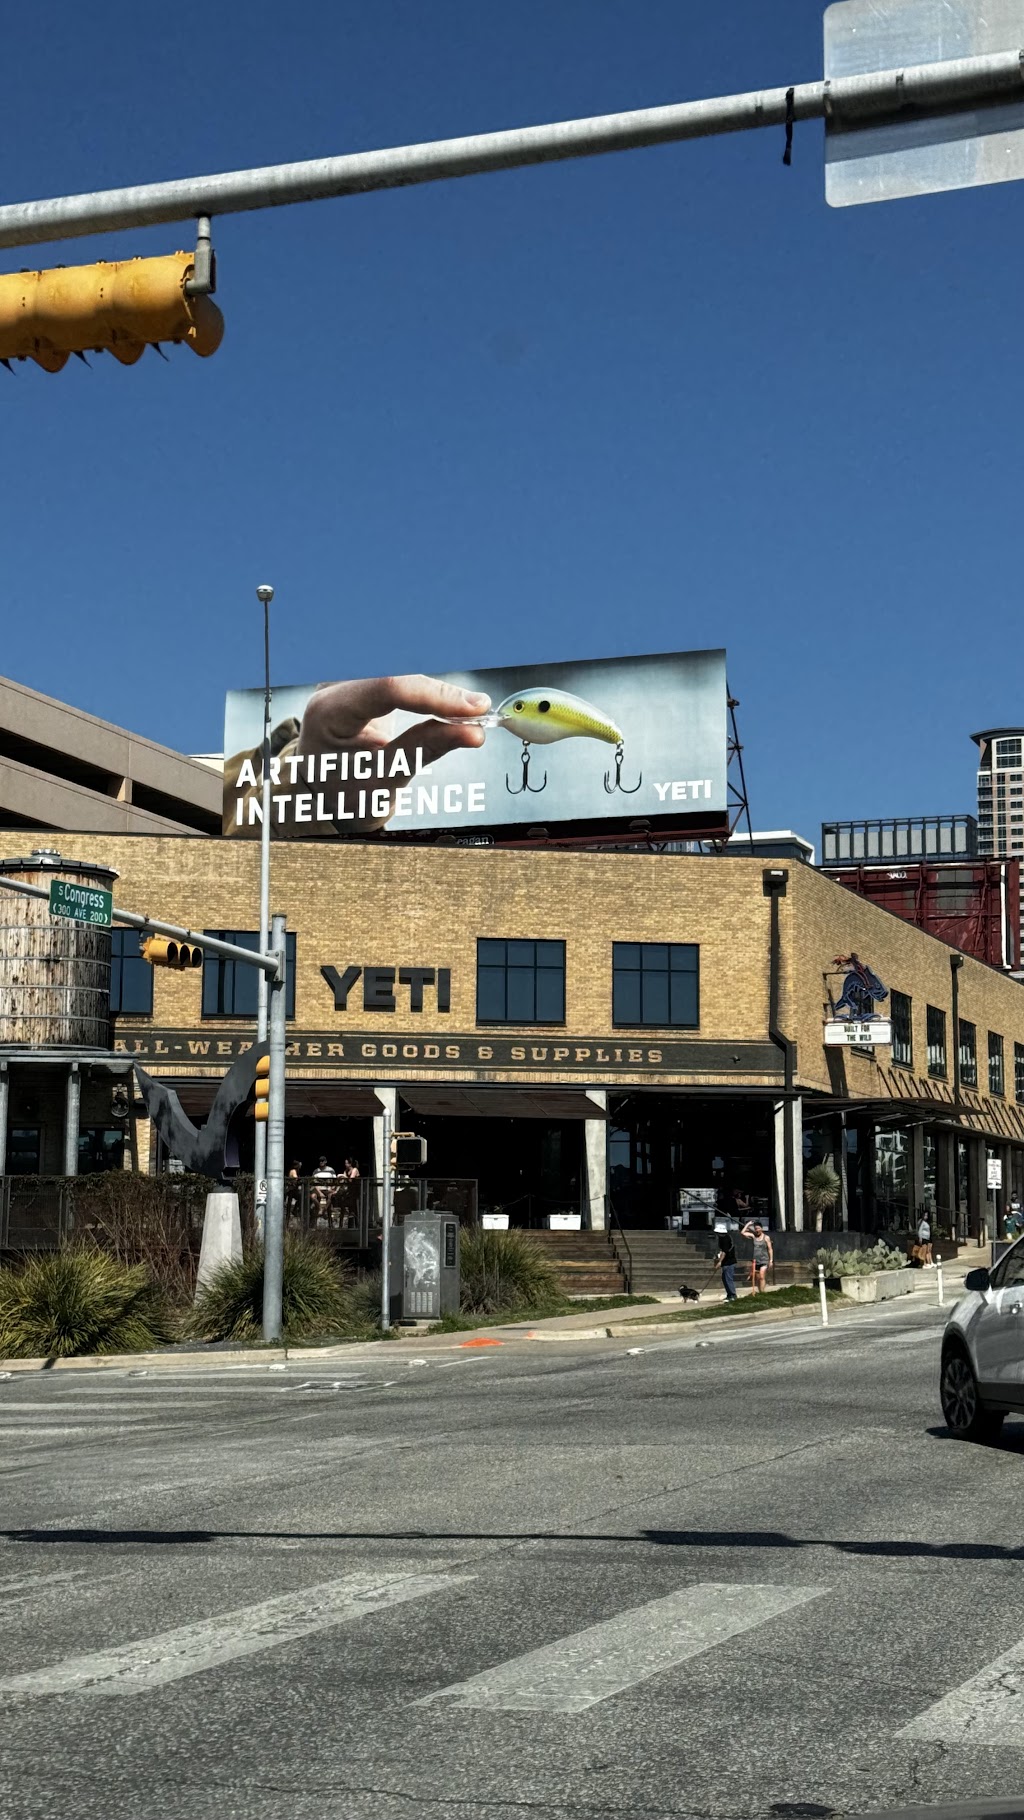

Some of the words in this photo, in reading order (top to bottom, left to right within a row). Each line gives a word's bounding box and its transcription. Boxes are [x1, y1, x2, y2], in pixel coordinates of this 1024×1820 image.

[235, 746, 433, 788] ARTIFICIAL
[653, 779, 712, 801] YETI
[235, 782, 486, 826] INTELLIGENCE
[456, 836, 489, 846] eagan
[58, 885, 64, 896] S
[64, 884, 105, 908] Congress
[57, 904, 71, 916] 300
[74, 907, 87, 919] AVE
[90, 911, 103, 923] 200
[320, 965, 451, 1013] YETI
[861, 1024, 870, 1032] FOR
[114, 1039, 345, 1057] ALL-WEAHER
[361, 1043, 461, 1059] GOODS
[478, 1046, 494, 1060] &
[510, 1046, 664, 1063] SUPPLIES
